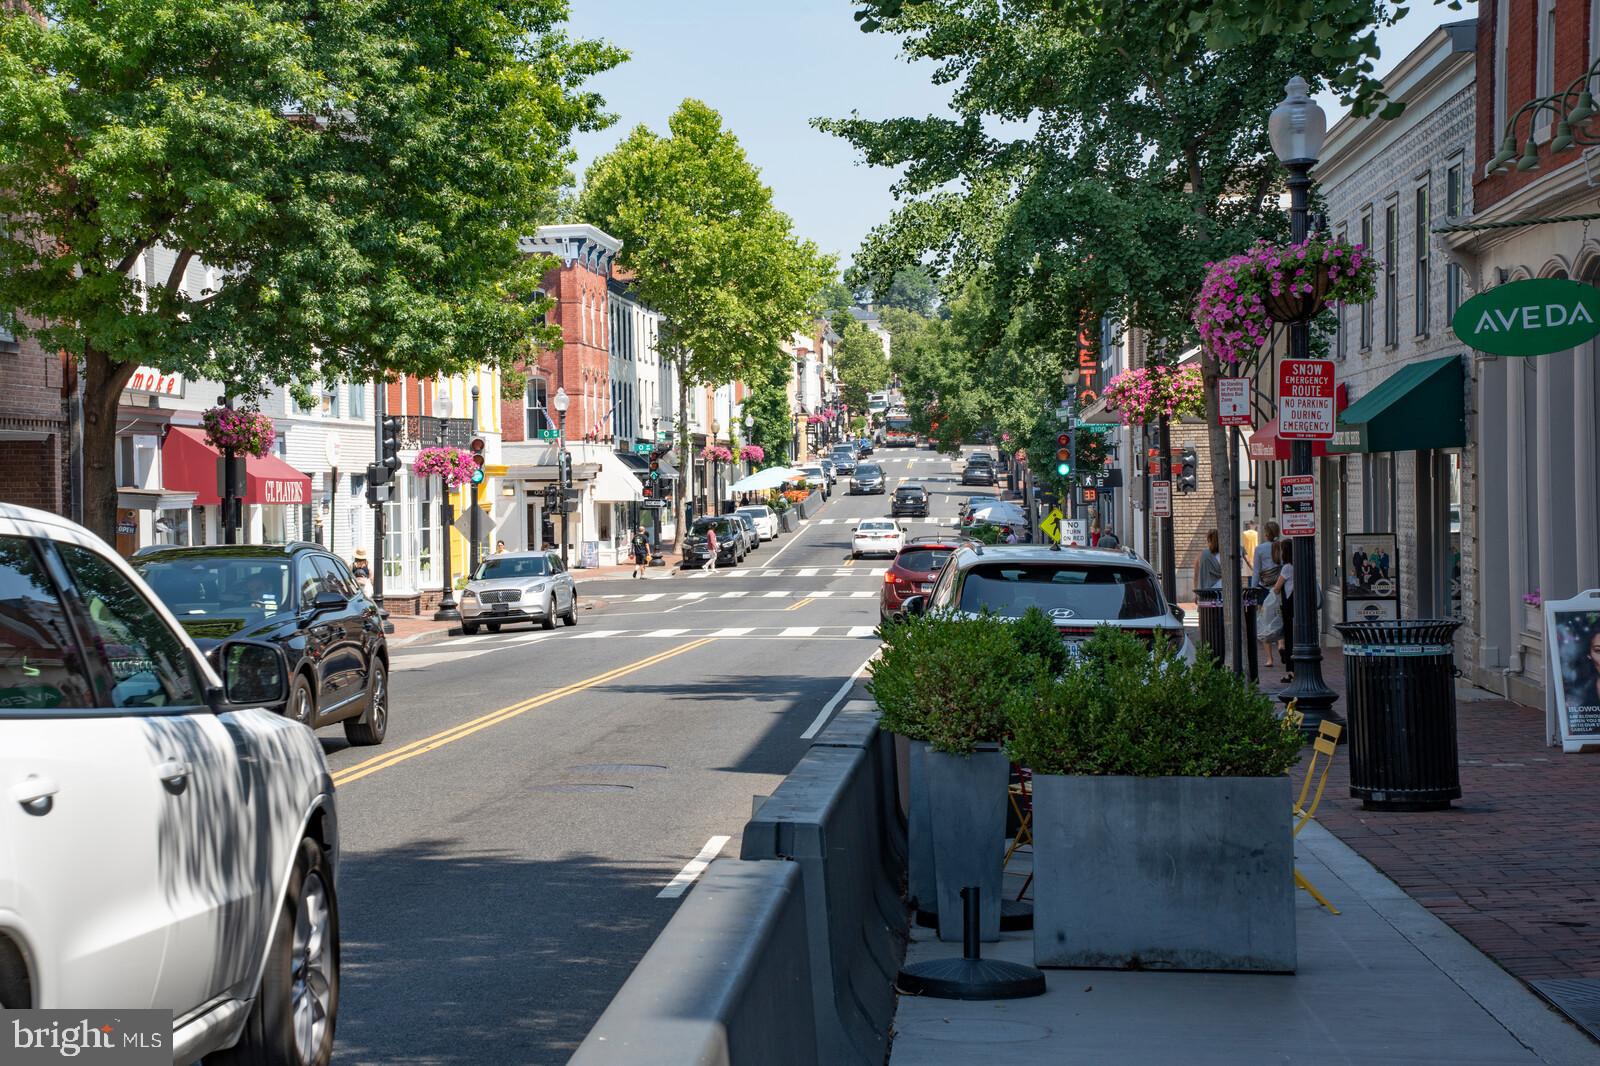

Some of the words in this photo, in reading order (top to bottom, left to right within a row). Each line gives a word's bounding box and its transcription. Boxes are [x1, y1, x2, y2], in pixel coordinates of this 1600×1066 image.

[1474, 301, 1594, 334] AVEDA
[1292, 364, 1323, 375] SNOW
[132, 373, 175, 394] moke
[1285, 376, 1329, 384] EMERGENCY
[1292, 386, 1322, 396] ROUTE
[1284, 400, 1295, 408] NO
[1298, 400, 1328, 408] PARKING
[1291, 410, 1322, 420] DURING
[1284, 422, 1330, 431] EMERGENCY
[276, 480, 302, 502] PLAYERS
[1282, 486, 1292, 494] 30
